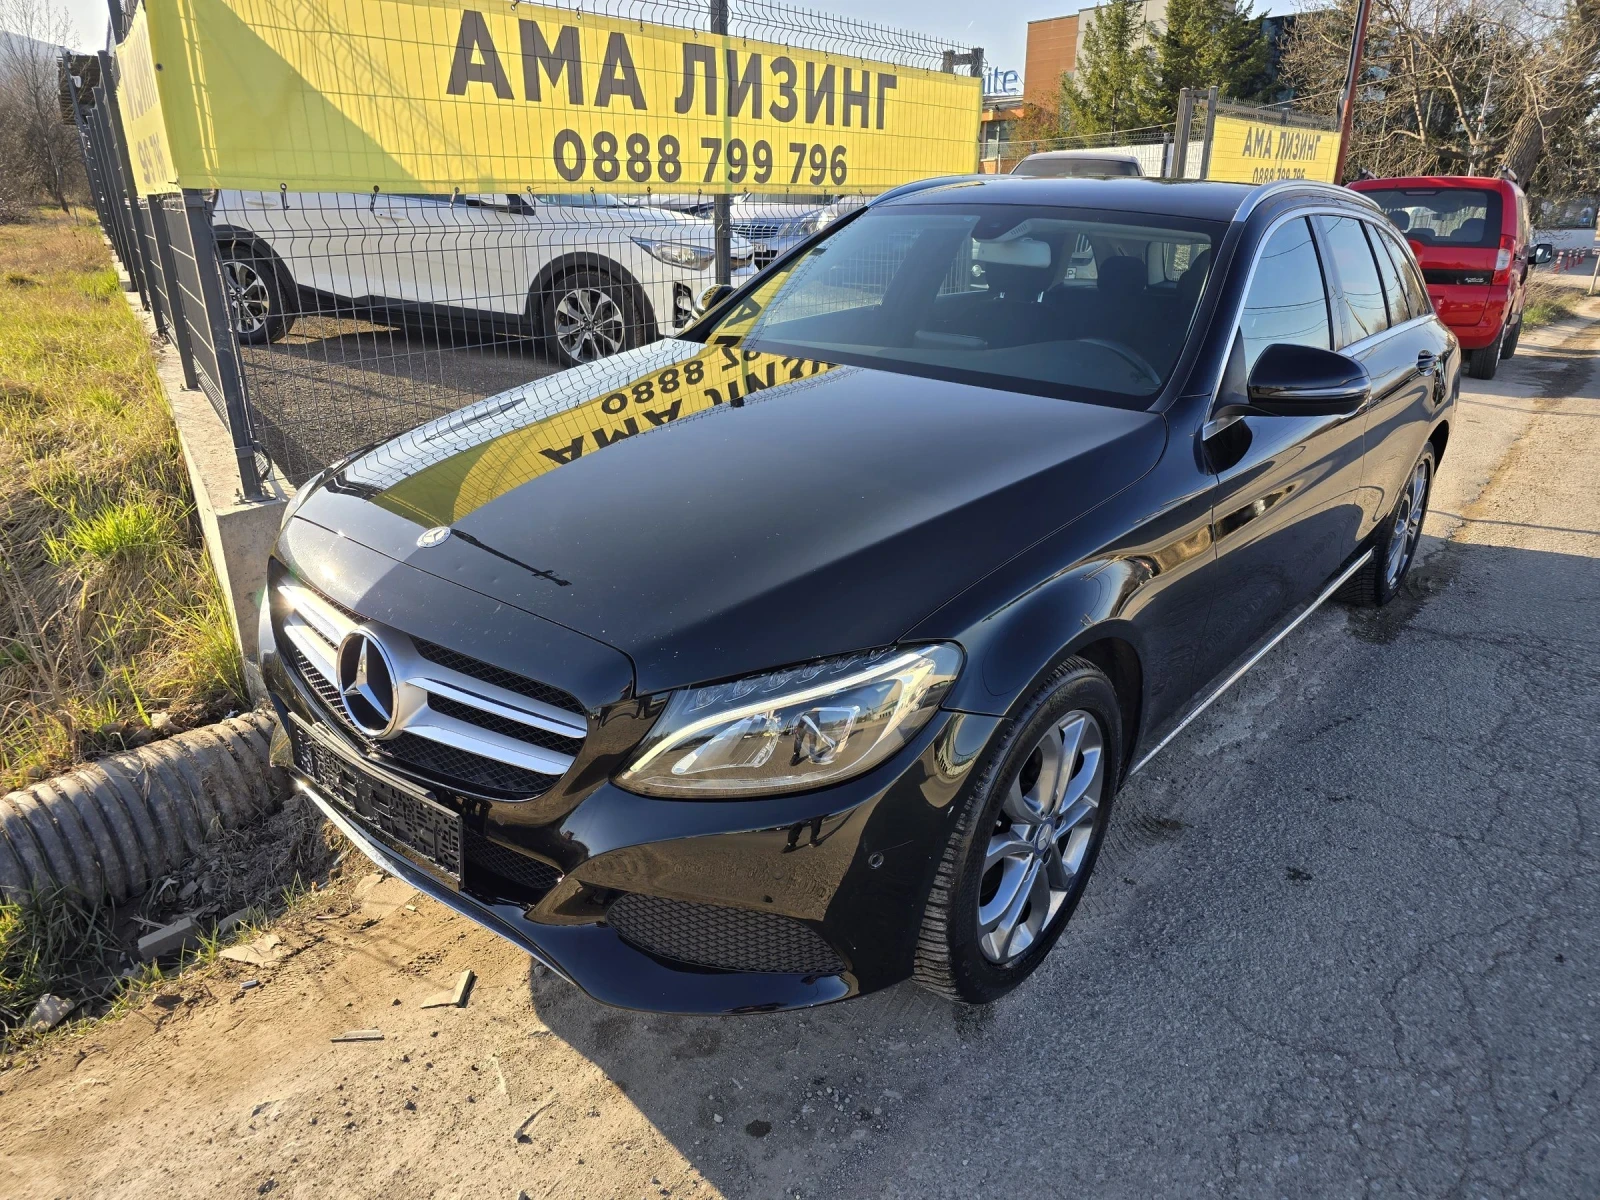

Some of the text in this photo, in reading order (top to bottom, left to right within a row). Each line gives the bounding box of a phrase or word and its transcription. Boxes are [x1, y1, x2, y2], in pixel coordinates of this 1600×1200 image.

[446, 10, 898, 130] АМА ЛИЗИНГ
[983, 66, 1018, 94] ite
[553, 128, 848, 187] 0888 799 796
[1242, 126, 1321, 160] АМА ЛИЗИНГ
[1252, 166, 1274, 183] 0888
